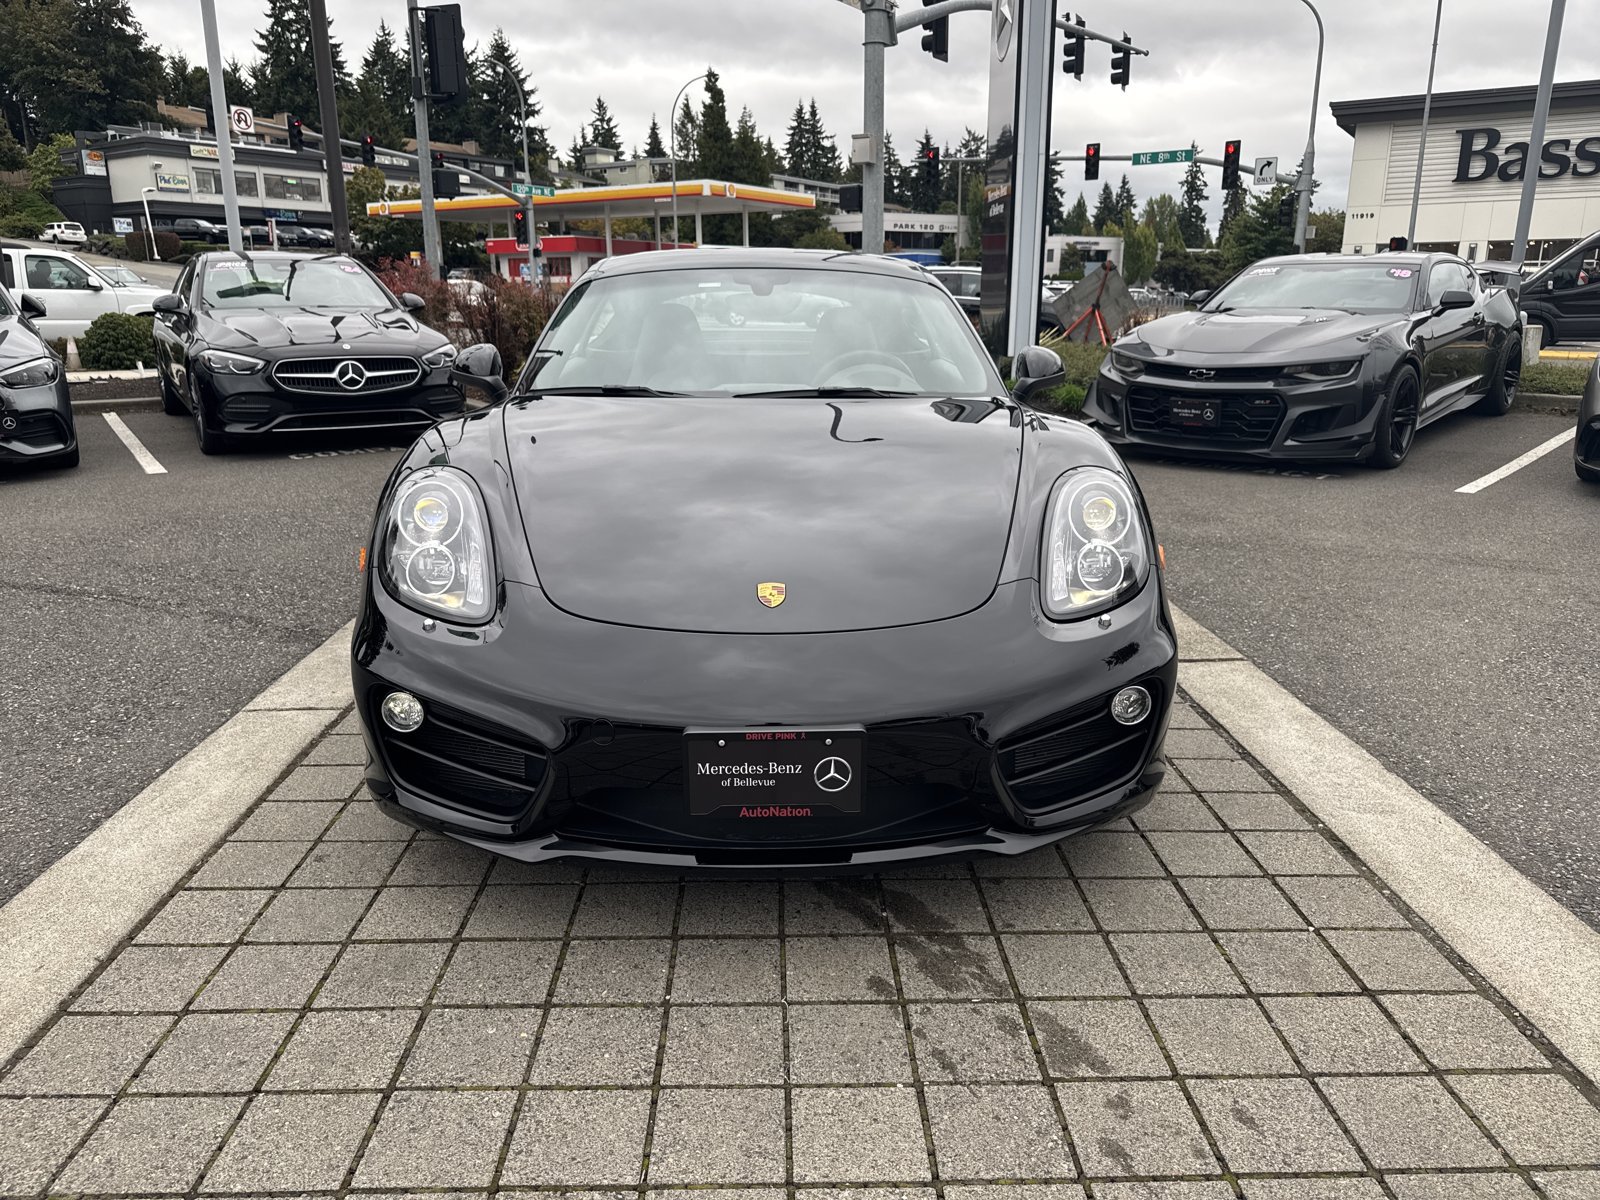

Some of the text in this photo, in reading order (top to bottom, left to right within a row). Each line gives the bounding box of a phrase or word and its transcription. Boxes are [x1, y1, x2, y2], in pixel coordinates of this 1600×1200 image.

[1140, 151, 1186, 164] NE 8th St
[1452, 127, 1600, 182] Bass
[516, 184, 529, 194] 120th
[544, 188, 552, 196] NE
[1352, 212, 1375, 220] 11919
[745, 732, 797, 741] DRIVE PINK
[697, 761, 803, 775] Mercedes-Benz
[721, 777, 776, 787] of Bellevue
[739, 806, 812, 818] AutoNation
